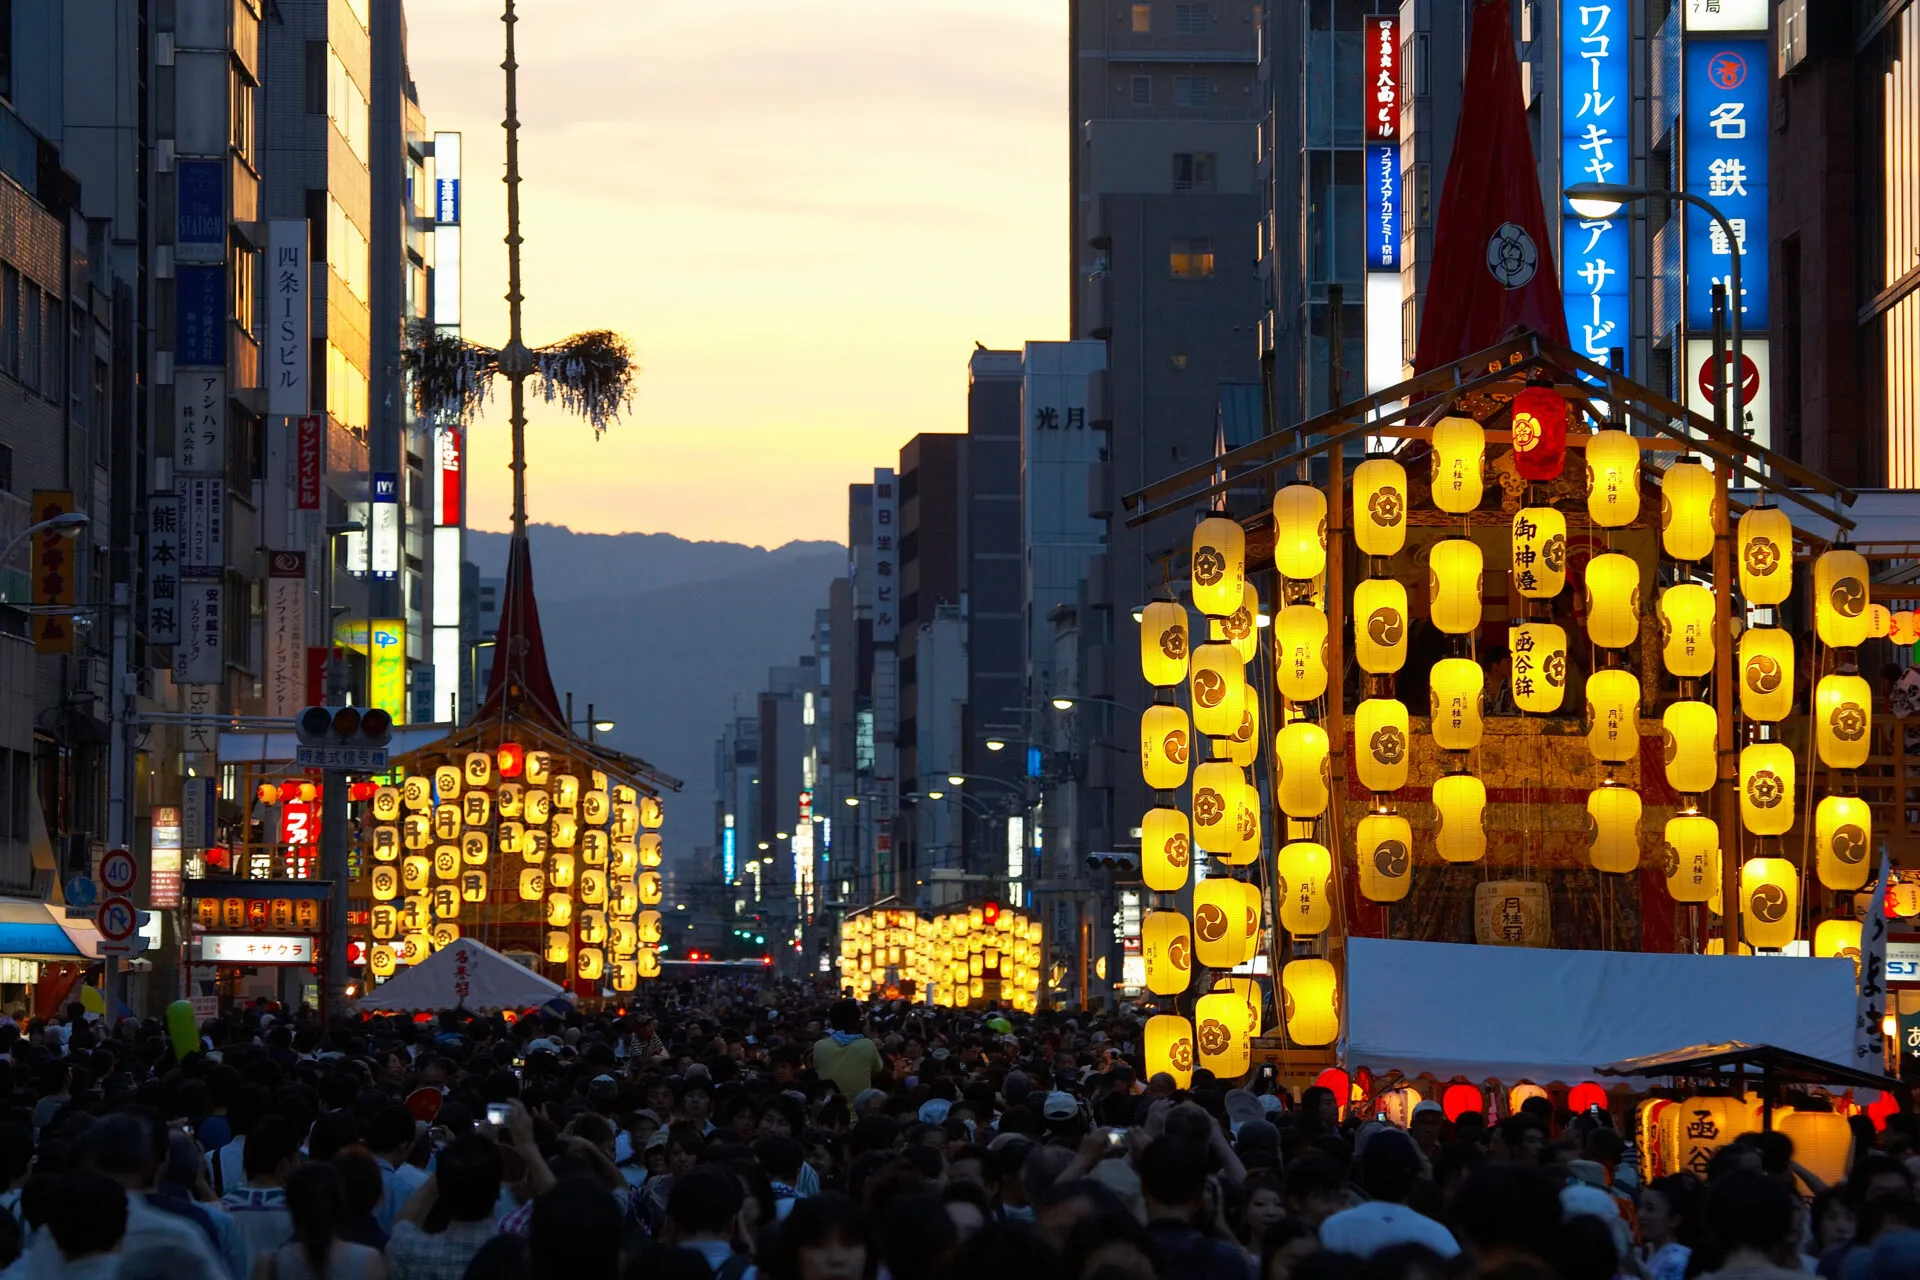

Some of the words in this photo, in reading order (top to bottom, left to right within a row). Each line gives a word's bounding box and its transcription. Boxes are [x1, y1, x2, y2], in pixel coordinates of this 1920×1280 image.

[1575, 4, 1616, 384] ワコールキャアサービ
[203, 377, 217, 445] アシハラ
[1035, 406, 1085, 431] 光月
[183, 406, 195, 466] 株式会社
[302, 420, 317, 504] サンケイビル
[376, 480, 395, 492] IVY
[152, 505, 177, 634] 熊本歯科
[300, 749, 384, 766] 時差式信号機
[437, 809, 456, 837] 月
[466, 797, 485, 824] 月
[375, 830, 395, 857] 月
[108, 862, 129, 881] 40
[464, 874, 482, 900] 月
[435, 889, 453, 916] 月
[374, 909, 393, 936] 月
[1502, 897, 1523, 942] 月桂冠
